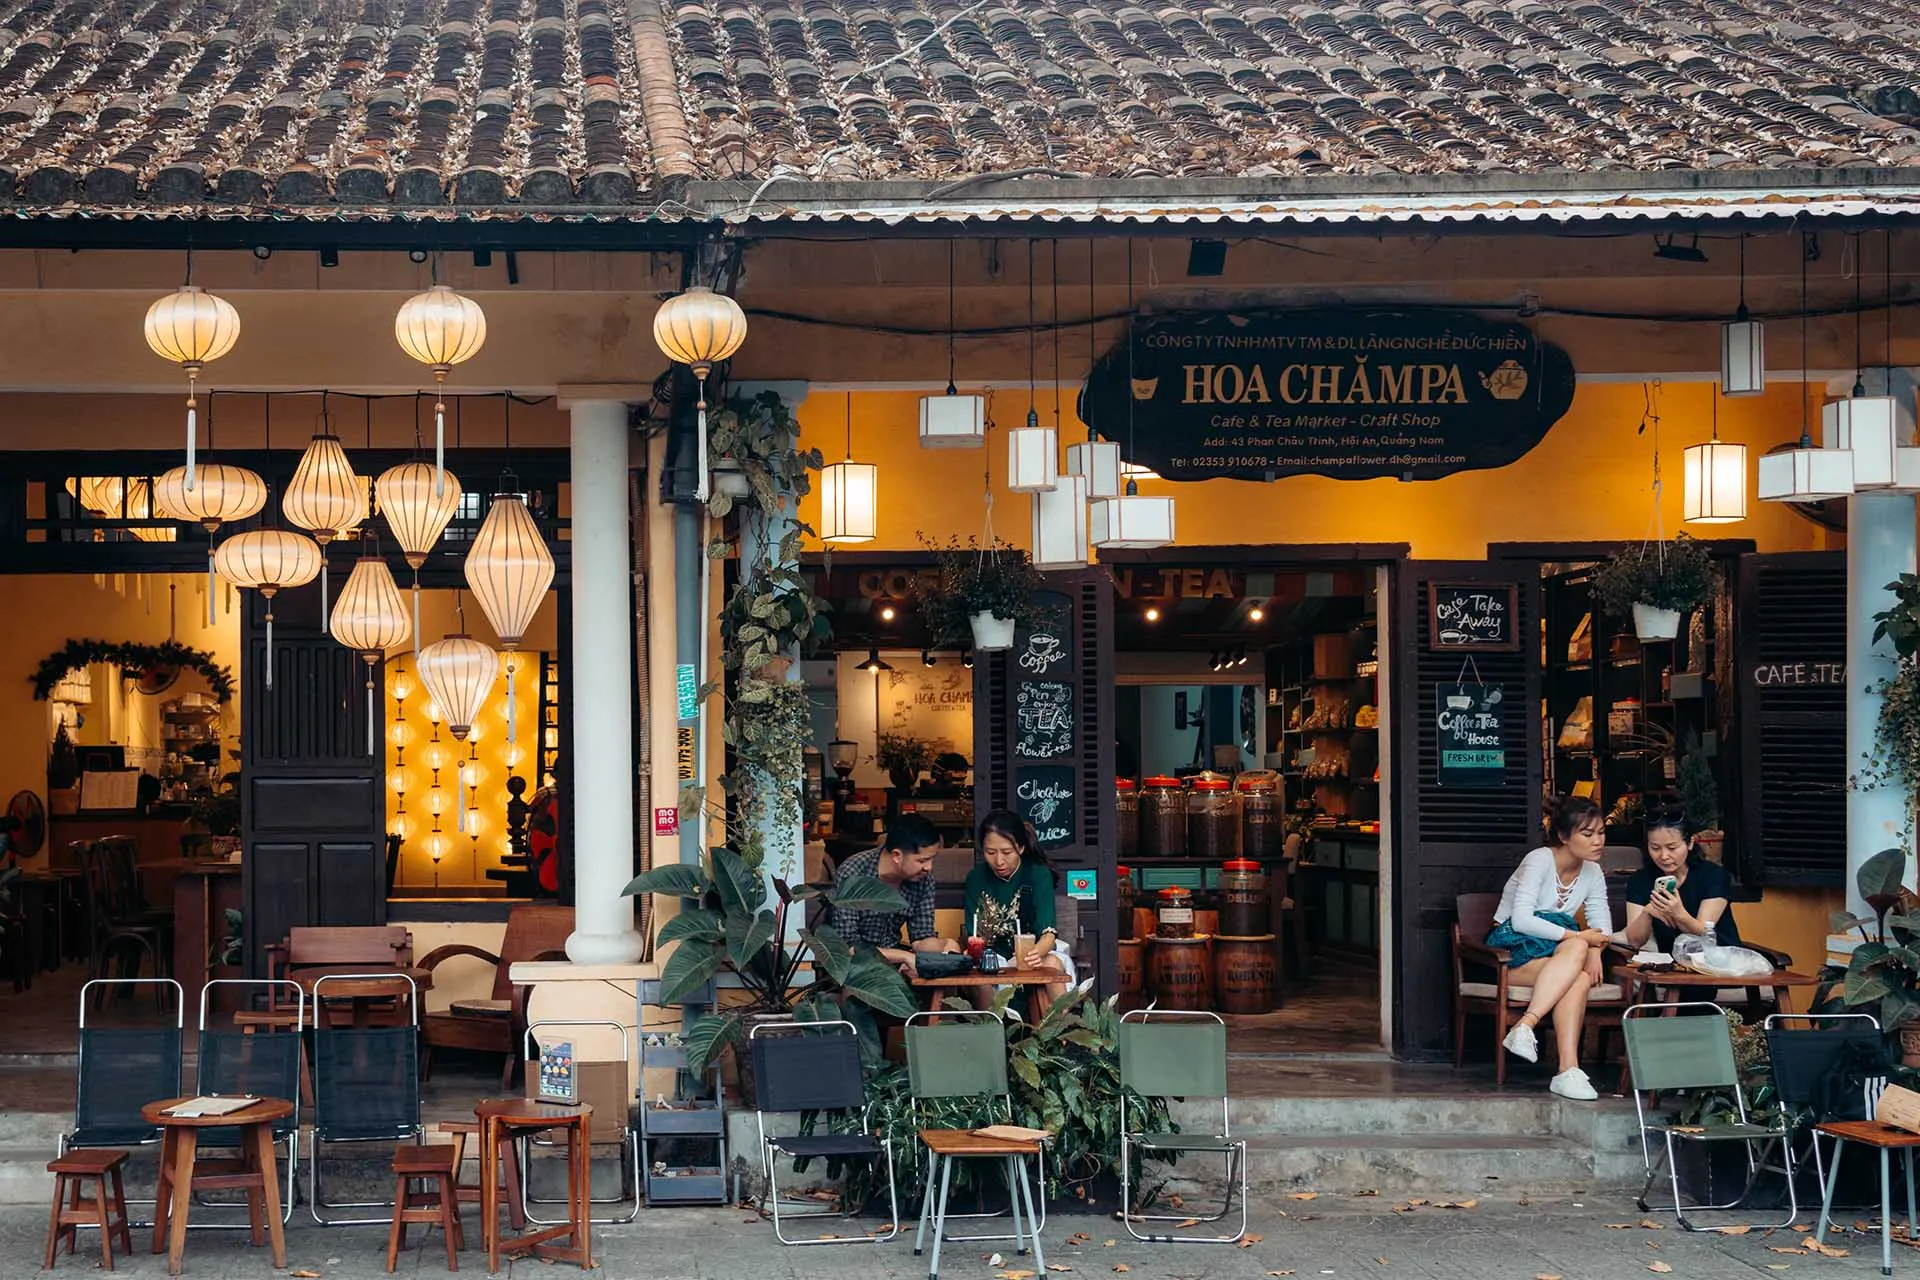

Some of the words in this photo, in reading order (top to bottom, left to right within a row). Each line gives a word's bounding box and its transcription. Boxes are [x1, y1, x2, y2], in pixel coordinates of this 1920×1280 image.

[1324, 336, 1338, 350] &
[1182, 364, 1272, 405] HOA
[1211, 415, 1245, 428] Cafe
[1249, 416, 1260, 428] &
[1265, 414, 1291, 428] Tea
[1360, 412, 1398, 428] Craft
[1401, 412, 1440, 429] Shop
[1231, 437, 1244, 447] 43
[1247, 437, 1274, 447] Phan
[1419, 436, 1444, 446] Nam
[1192, 456, 1225, 467] 02353
[1228, 456, 1267, 467] 910678
[1158, 567, 1235, 600] TEA
[1469, 594, 1504, 616] Take
[1019, 651, 1067, 674] Coffee
[940, 690, 974, 704] CHAM
[1018, 708, 1069, 730] TEA
[1468, 732, 1500, 745] House
[1447, 753, 1474, 763] FRESH
[1035, 826, 1071, 842] uice
